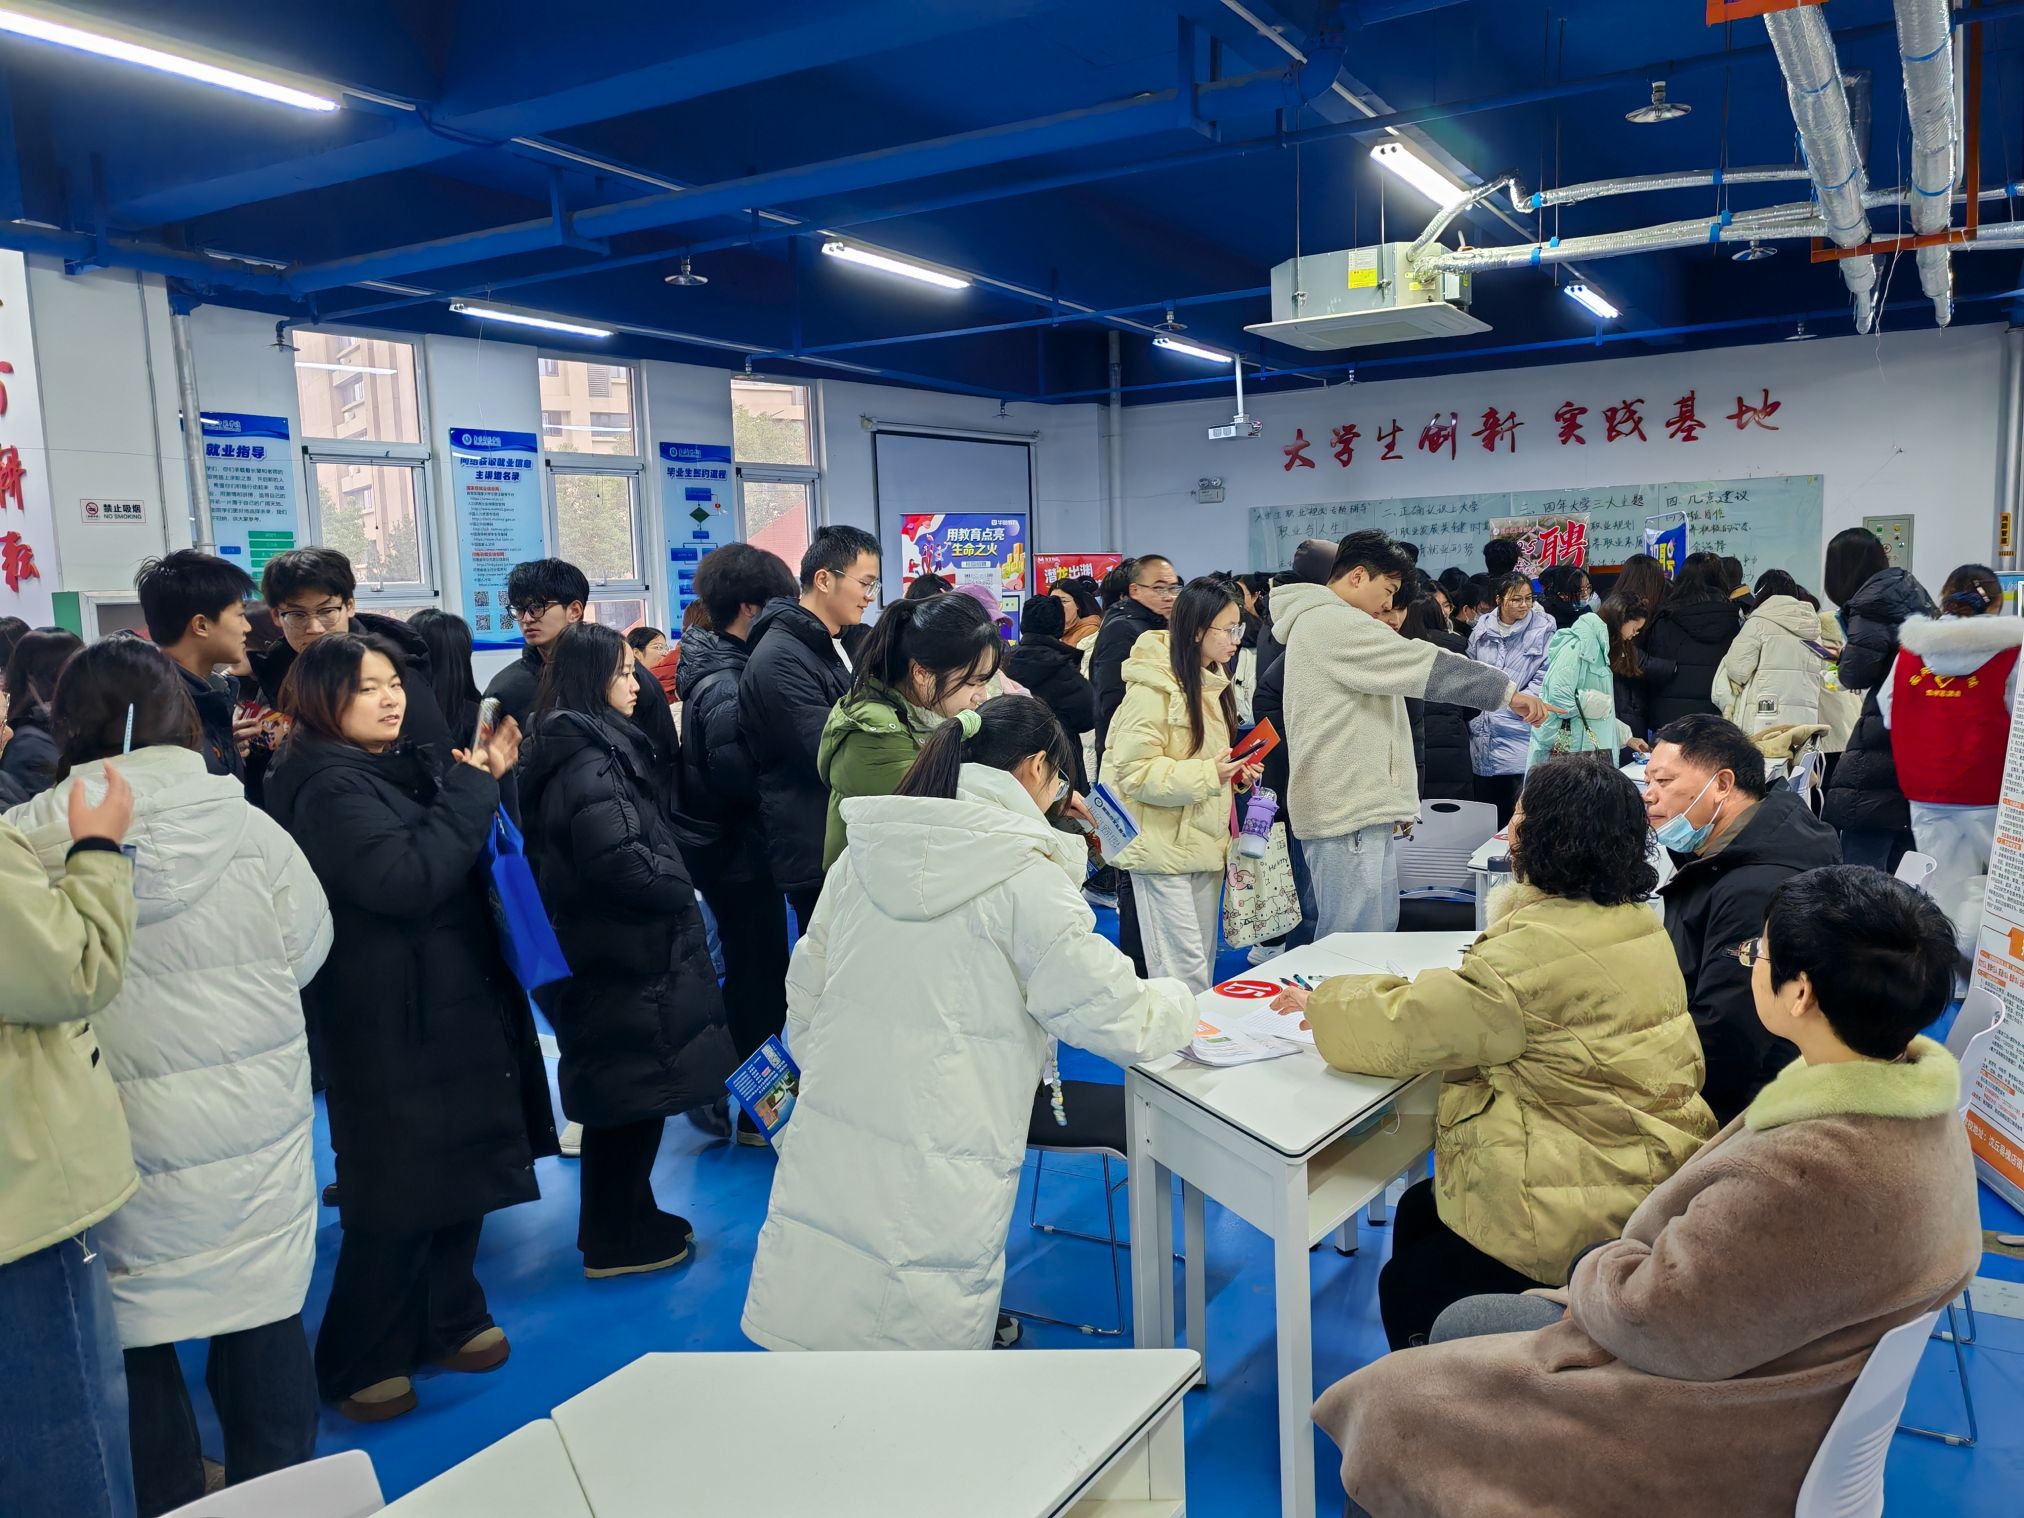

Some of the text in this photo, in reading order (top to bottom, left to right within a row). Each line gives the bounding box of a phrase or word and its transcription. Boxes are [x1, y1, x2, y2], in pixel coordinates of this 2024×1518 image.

[1284, 388, 1782, 472] 大学生创新实践基地
[206, 443, 265, 458] 就业指导
[667, 466, 727, 479] 毕业生签约流程
[103, 504, 142, 513] 禁止吸烟
[947, 528, 1005, 541] 用教育点亮
[952, 543, 998, 557] 生命之火
[1537, 520, 1589, 568] 聘
[1044, 563, 1094, 583] 潜龙出渊
[1223, 981, 1273, 998] 15
